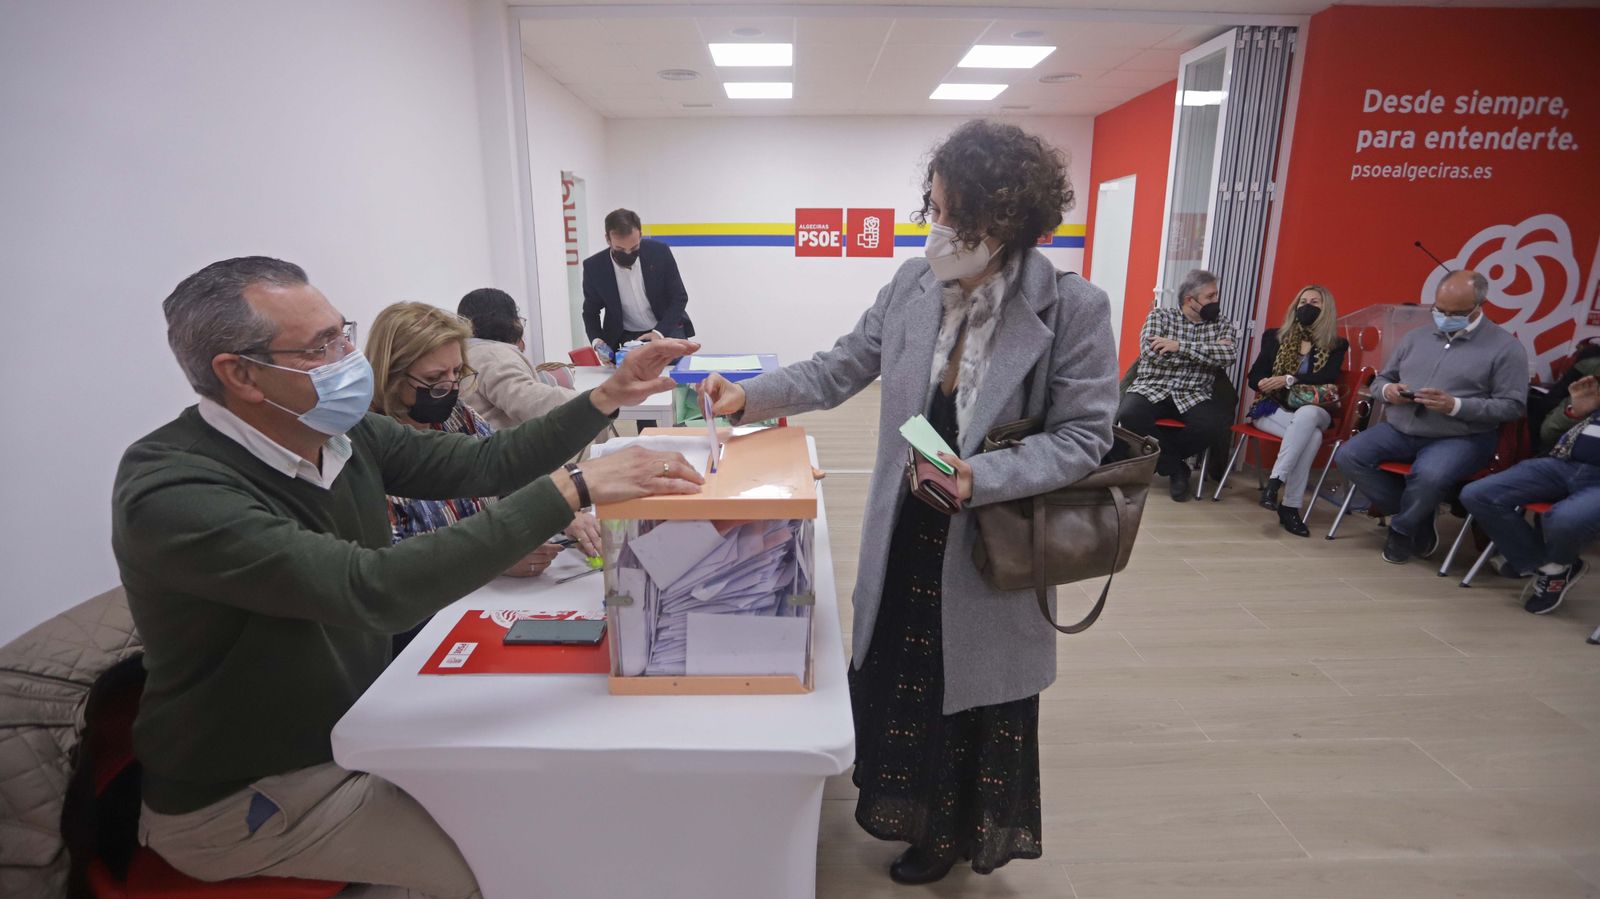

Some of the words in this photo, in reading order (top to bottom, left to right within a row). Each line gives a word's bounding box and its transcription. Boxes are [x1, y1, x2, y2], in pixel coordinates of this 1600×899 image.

[1363, 88, 1445, 114] Desde
[1453, 89, 1569, 119] siempre,
[1356, 128, 1416, 153] para
[1424, 126, 1579, 151] entenderte.
[1351, 162, 1493, 182] psoealgeciras.es
[798, 231, 840, 247] PSOE
